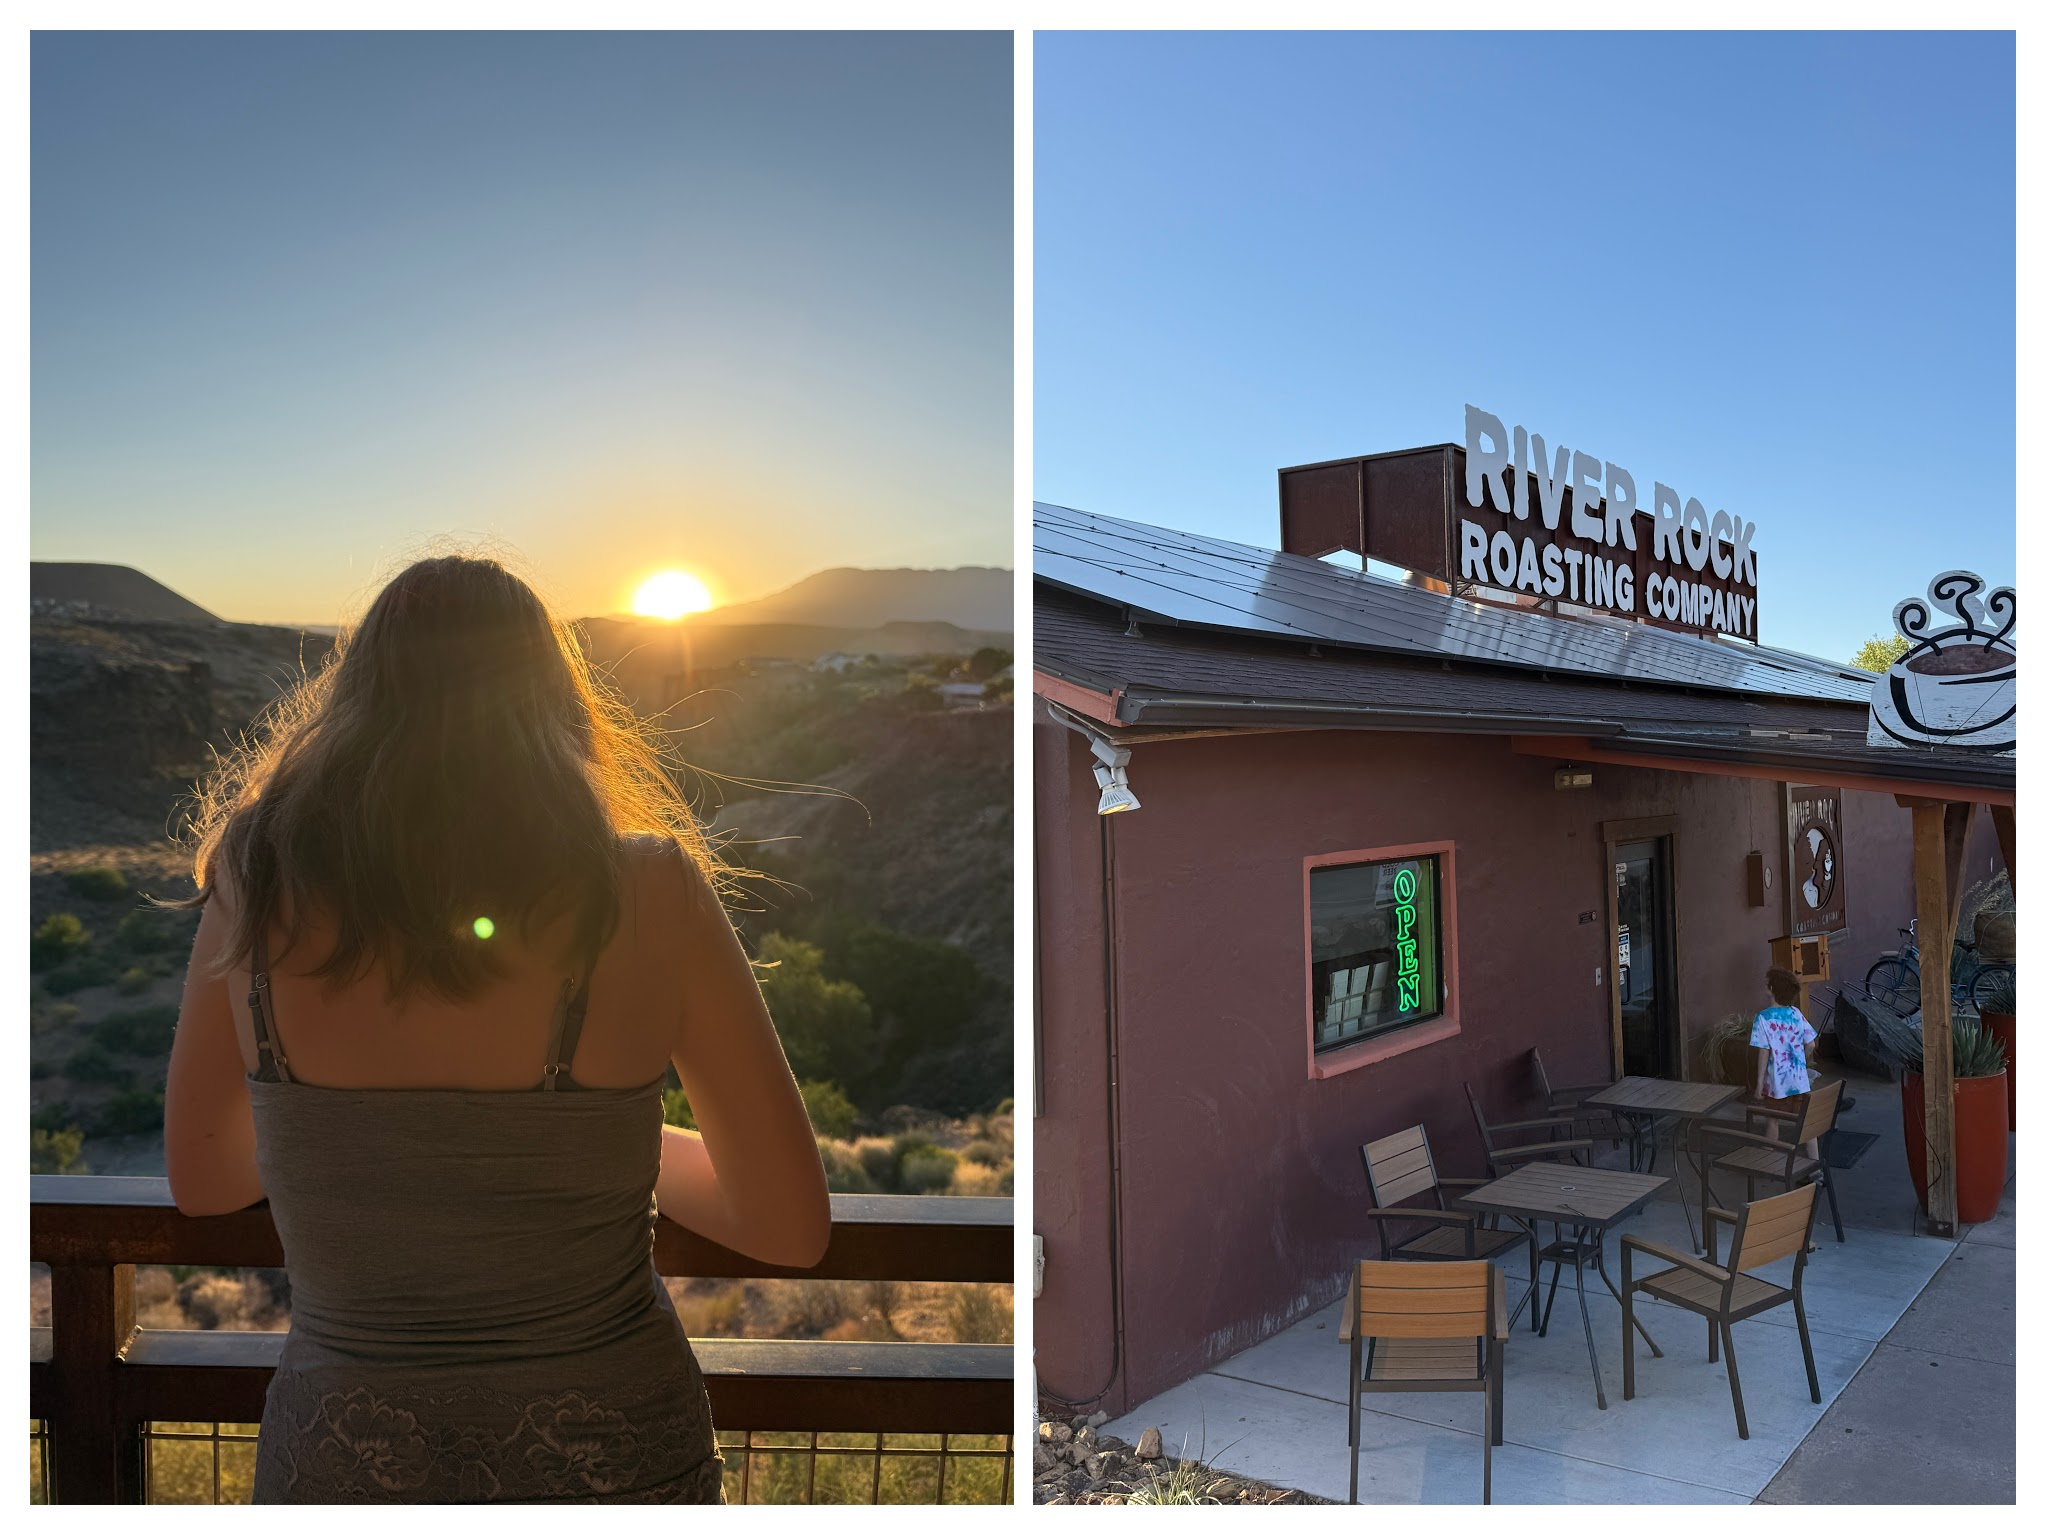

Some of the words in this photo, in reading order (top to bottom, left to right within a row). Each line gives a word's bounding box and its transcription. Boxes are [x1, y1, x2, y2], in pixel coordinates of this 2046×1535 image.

[1465, 403, 1637, 550] RIVER
[1654, 481, 1756, 587] ROCK
[1461, 518, 1634, 612] ROASTING
[1646, 572, 1755, 636] COMPANY
[1394, 869, 1420, 1012] OPEN
